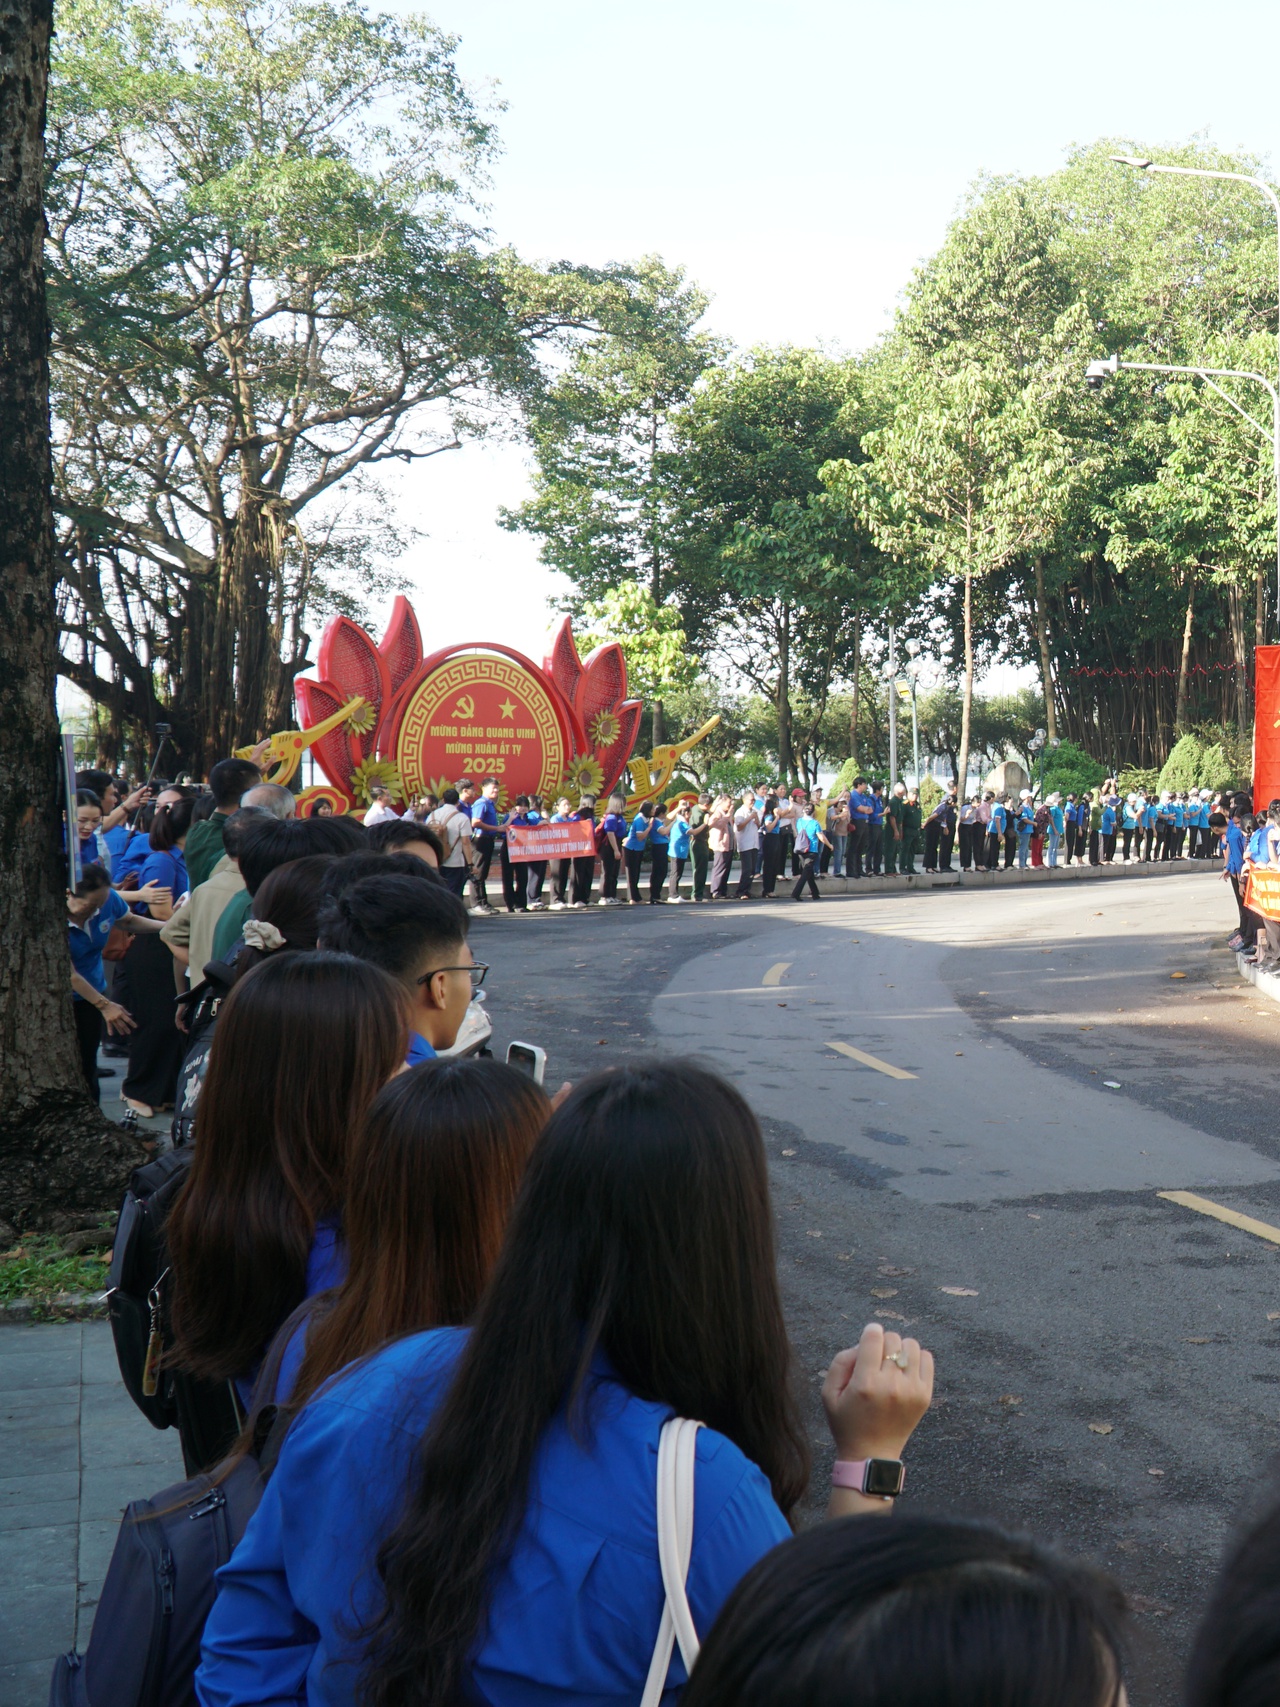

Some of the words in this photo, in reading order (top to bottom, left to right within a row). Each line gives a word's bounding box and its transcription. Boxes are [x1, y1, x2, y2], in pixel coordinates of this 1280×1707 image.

[431, 724, 458, 737] MỪNG
[460, 724, 484, 738] ĐẢNG
[486, 727, 514, 738] QUANG
[516, 728, 536, 739] VINH
[445, 741, 472, 754] MỪNG
[475, 742, 497, 754] XUÂN
[500, 741, 510, 754] ẤT
[512, 744, 522, 757] TỴ
[463, 757, 506, 773] 2025
